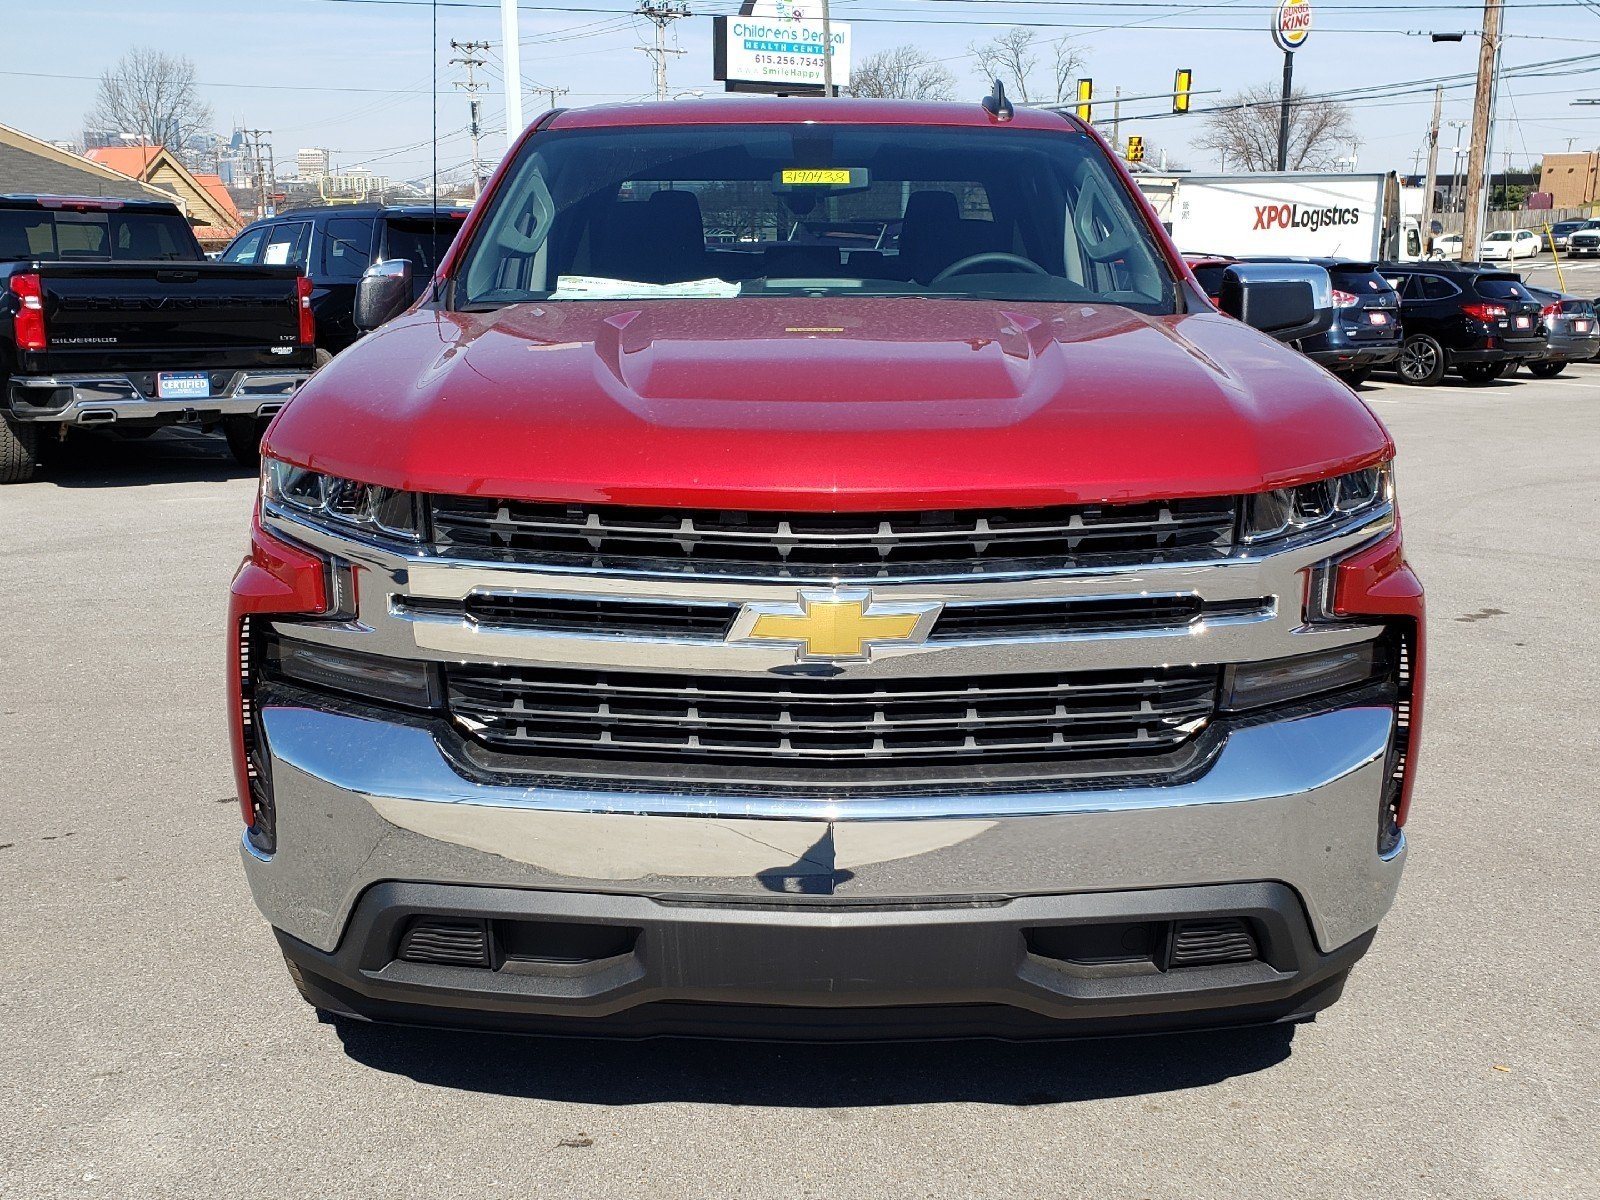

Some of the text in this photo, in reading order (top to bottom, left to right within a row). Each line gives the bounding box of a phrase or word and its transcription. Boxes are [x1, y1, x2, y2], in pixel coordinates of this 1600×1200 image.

[1282, 14, 1309, 31] KING
[733, 23, 798, 40] Children's
[745, 41, 787, 51] HEALTH
[755, 54, 825, 67] 615.256.7543
[162, 380, 208, 390] CERTIFIED
